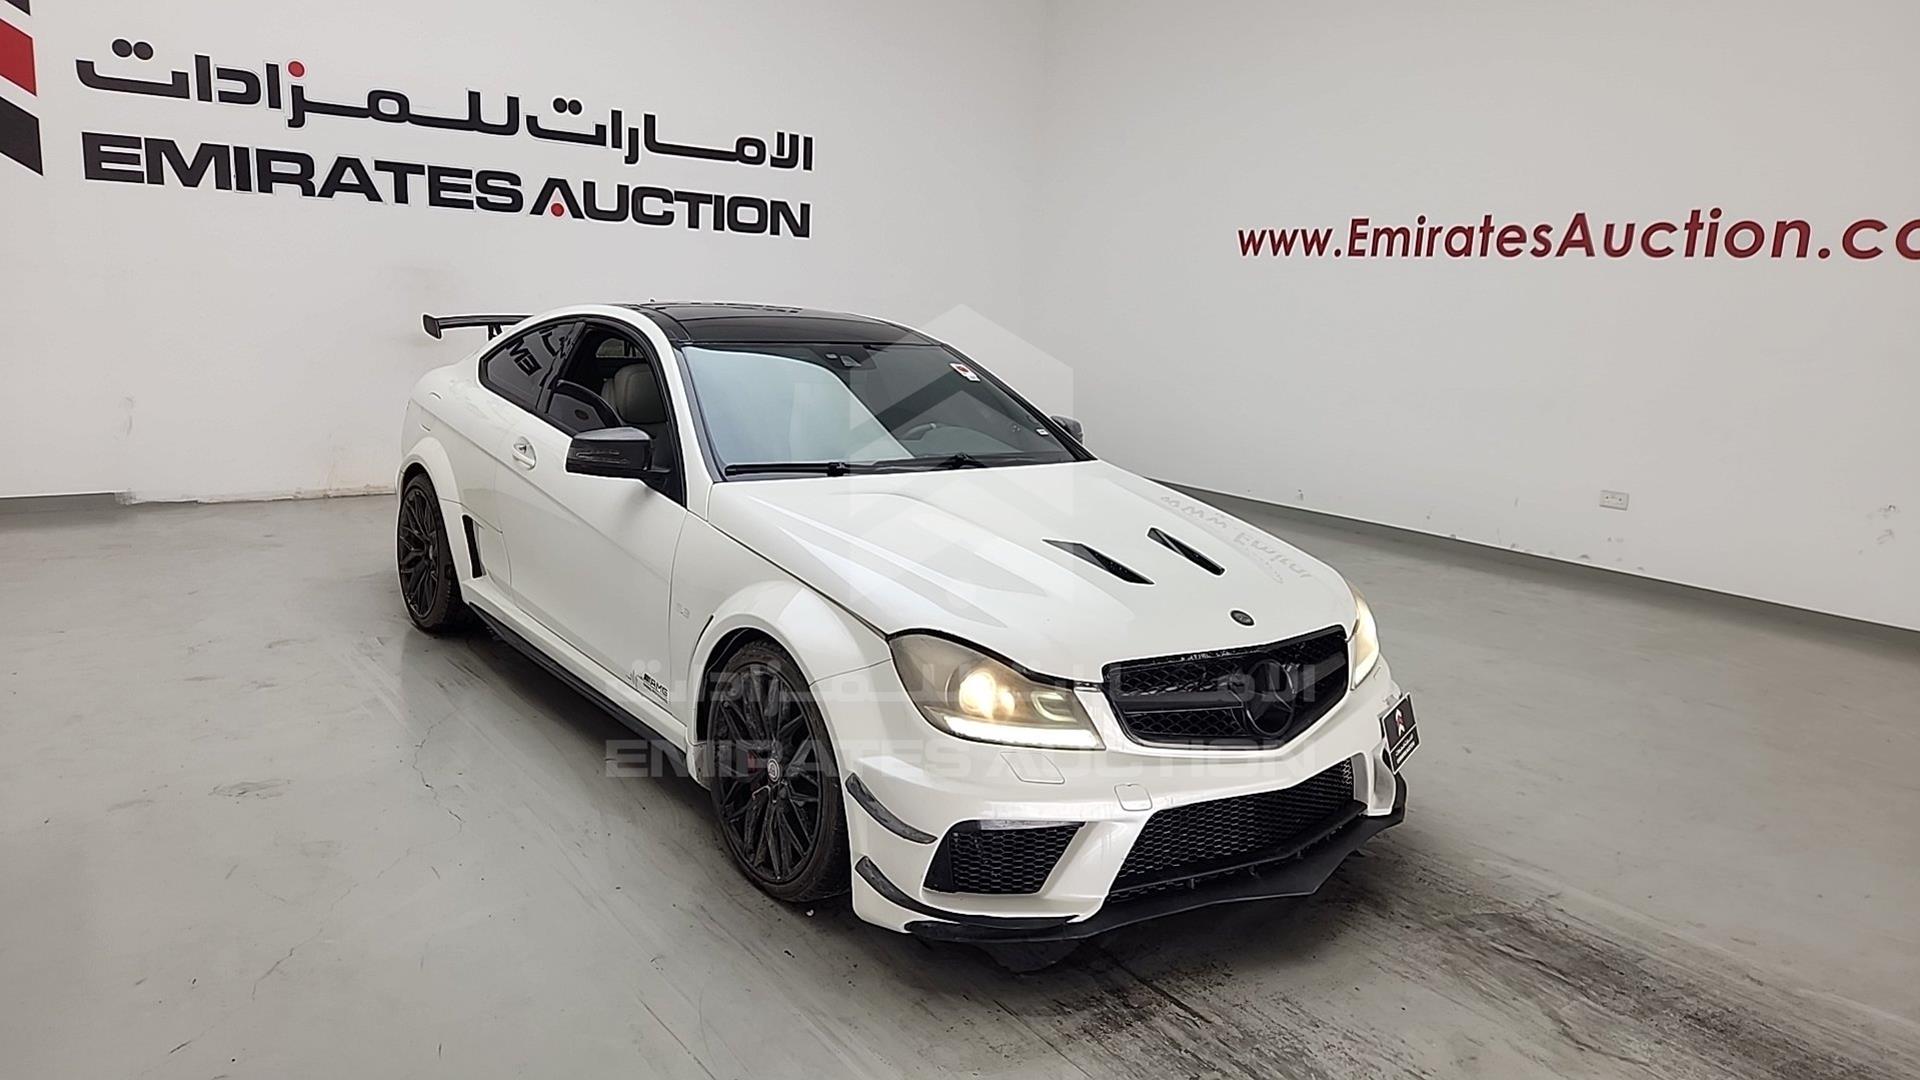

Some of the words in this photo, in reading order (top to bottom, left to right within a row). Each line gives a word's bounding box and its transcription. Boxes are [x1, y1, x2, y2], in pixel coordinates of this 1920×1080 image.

[75, 38, 520, 136] للمزادات
[81, 131, 524, 213] EMIRATES
[529, 177, 811, 238] AUCTION
